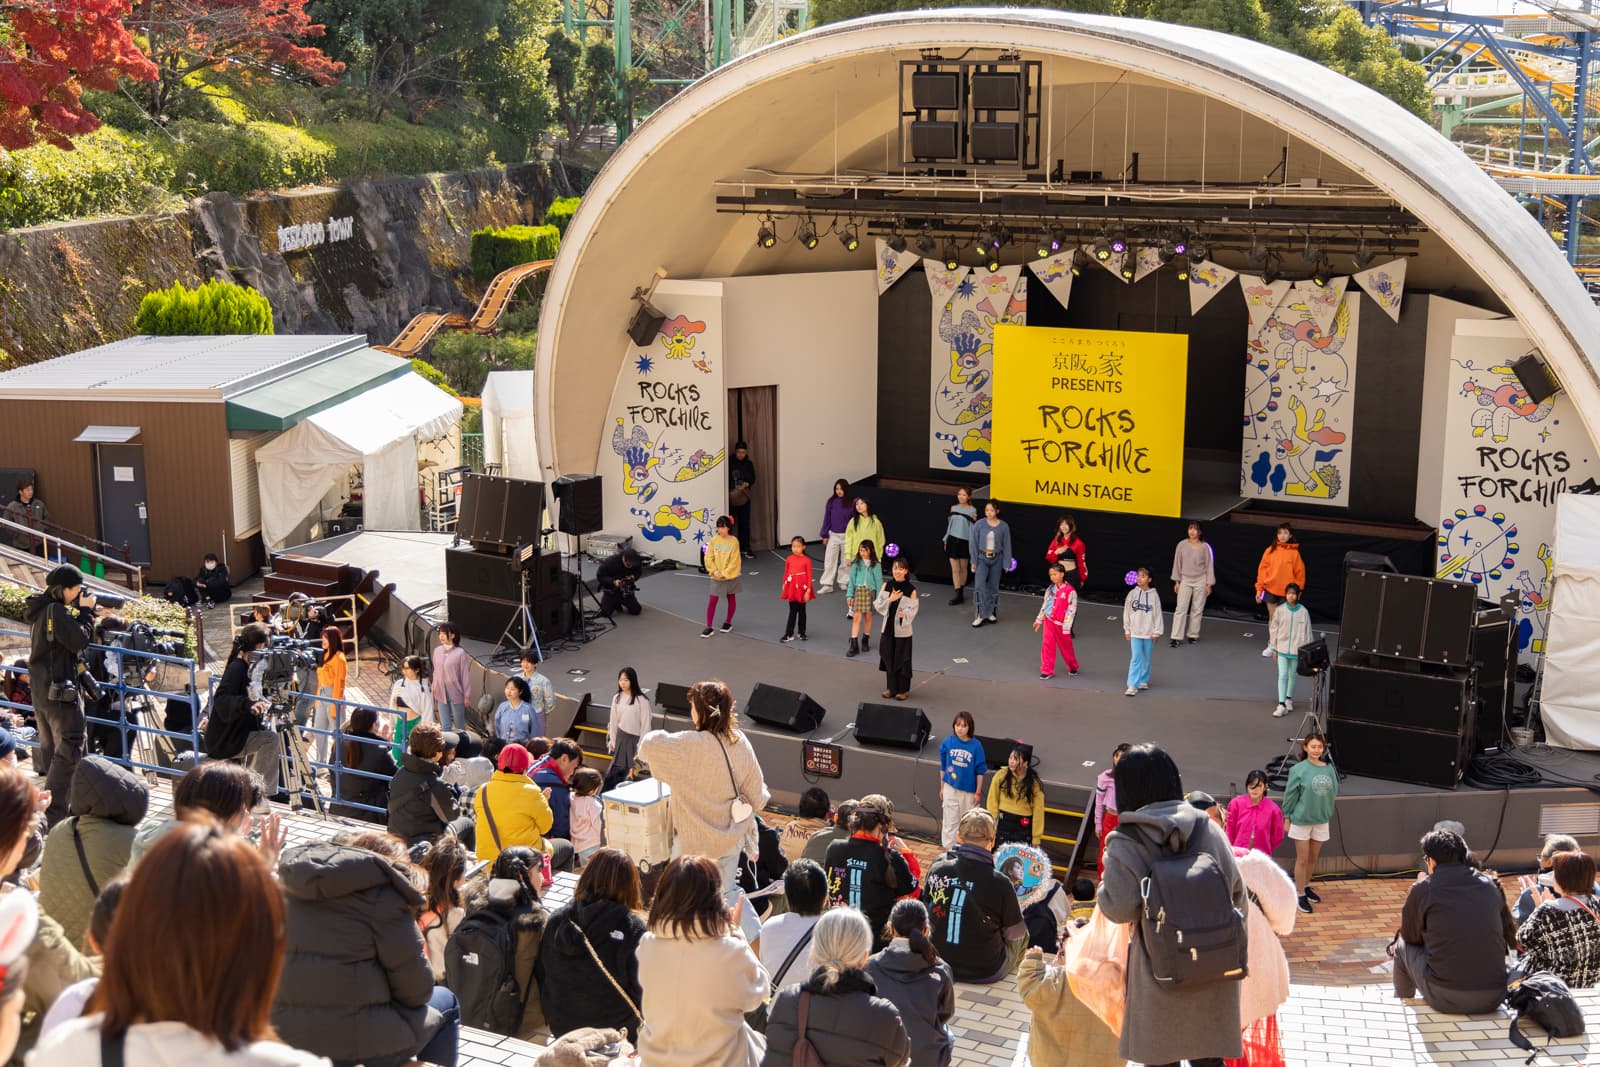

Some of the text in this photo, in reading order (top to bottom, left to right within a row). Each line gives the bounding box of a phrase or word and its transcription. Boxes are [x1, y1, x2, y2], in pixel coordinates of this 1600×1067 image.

[1051, 351, 1125, 378] 京阪の家
[637, 381, 701, 406] ROCKS
[1051, 377, 1123, 394] PRESENTS
[1038, 405, 1136, 439] ROCKS
[1476, 446, 1571, 478] ROCKS
[1035, 479, 1134, 502] MAIN STAGE
